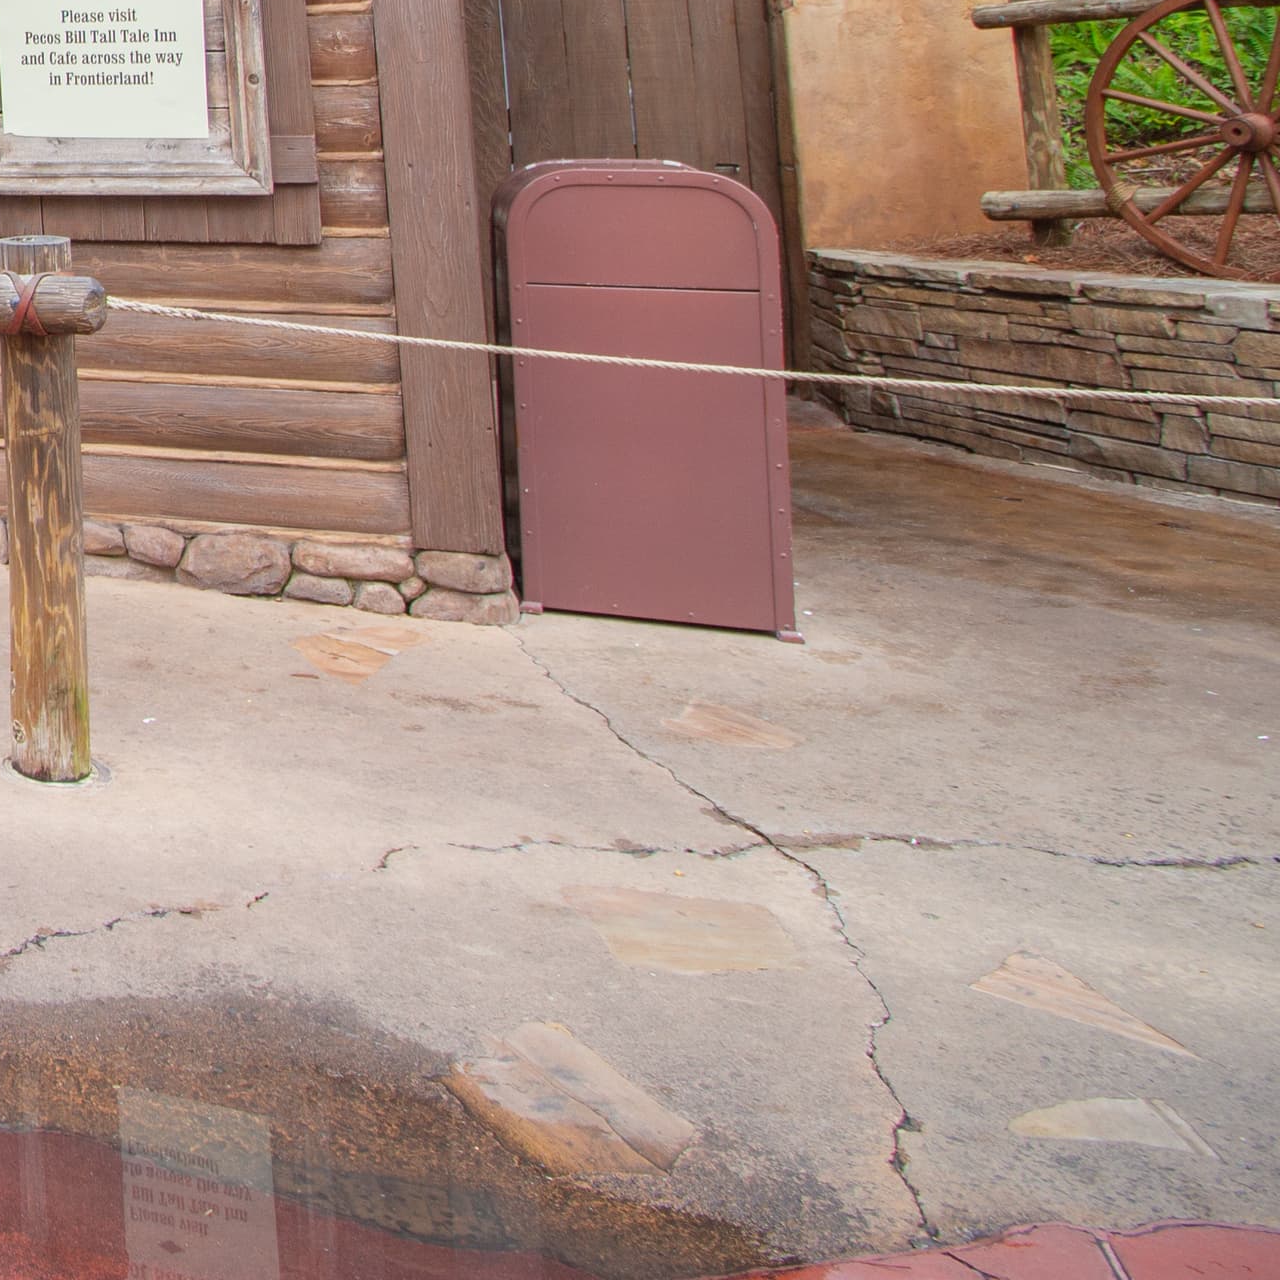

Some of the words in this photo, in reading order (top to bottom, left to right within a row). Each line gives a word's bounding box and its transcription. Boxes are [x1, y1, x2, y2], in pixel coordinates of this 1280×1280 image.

[61, 9, 105, 24] Please
[108, 8, 138, 23] visit
[25, 31, 61, 45] Pecos
[65, 30, 86, 44] Bill
[90, 29, 116, 44] Tall
[120, 28, 150, 43] Tale
[154, 28, 177, 43] Inn
[21, 51, 45, 66] and
[49, 51, 78, 65] Cafe
[81, 52, 126, 65] across
[129, 50, 151, 64] the
[156, 52, 183, 67] way
[49, 71, 62, 86] in
[65, 71, 154, 86] Frontierland!
